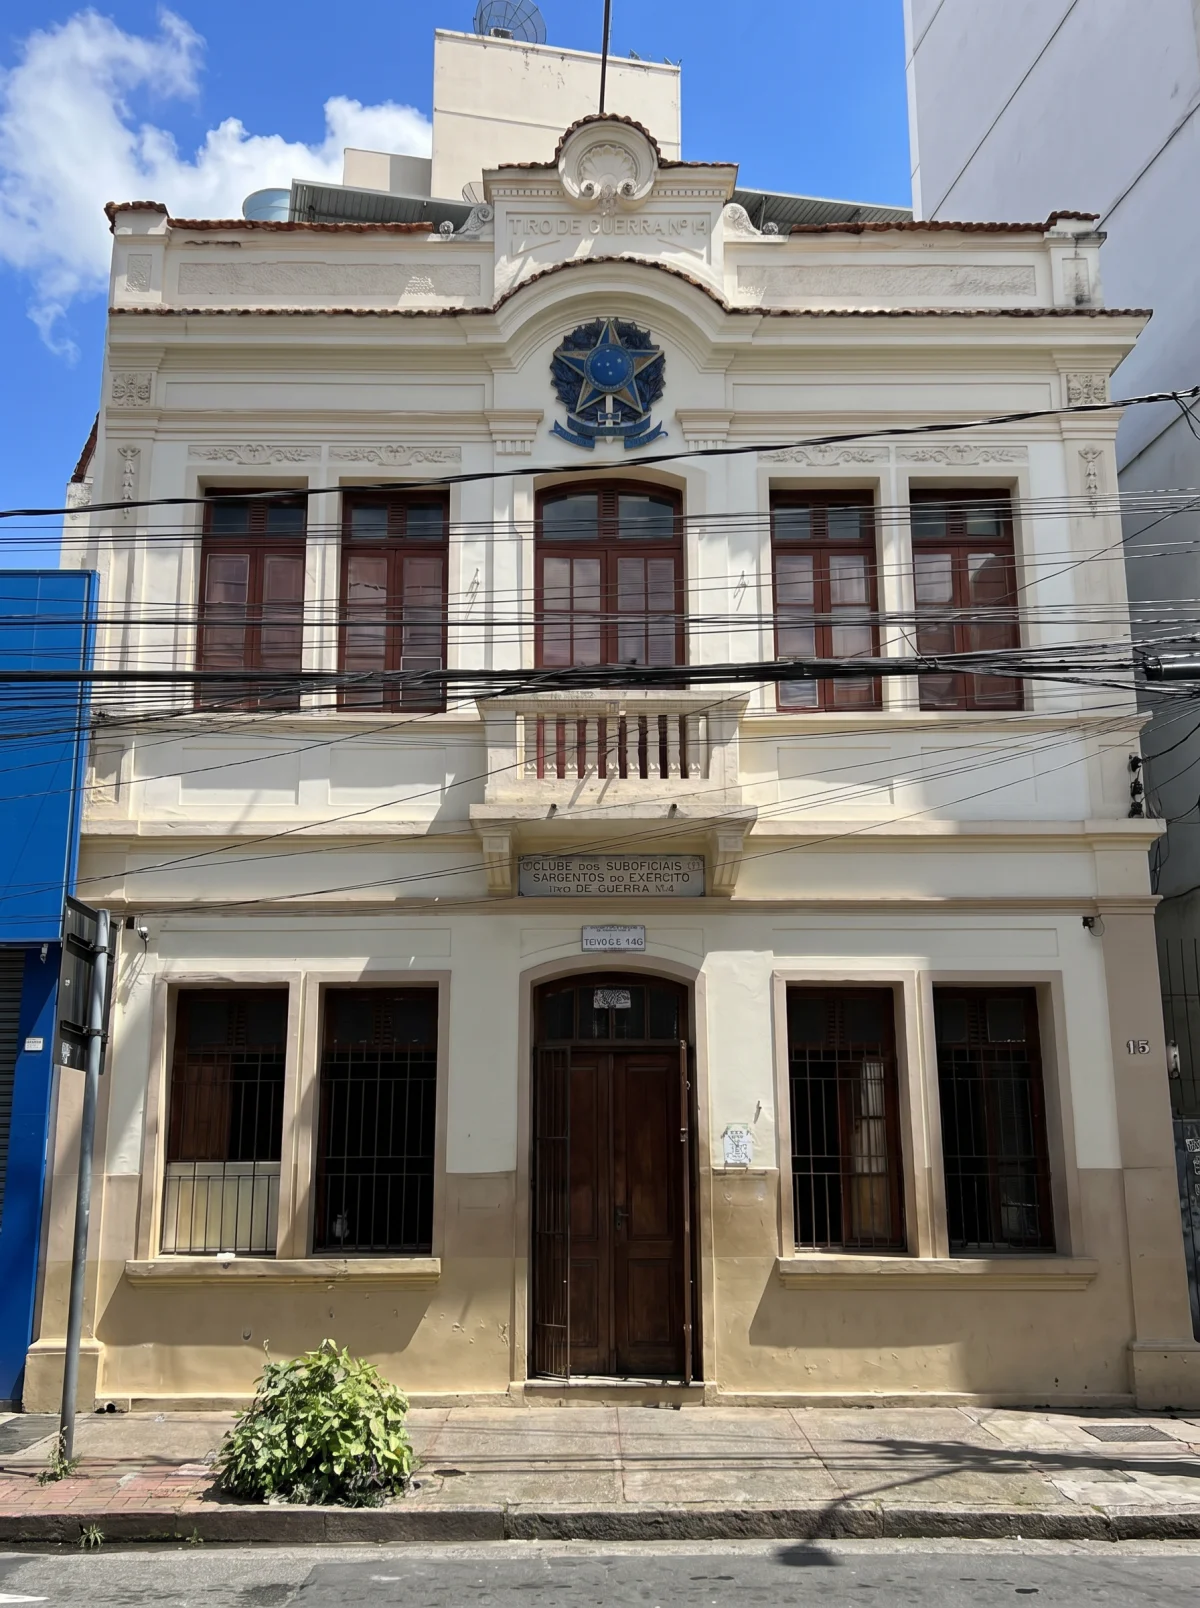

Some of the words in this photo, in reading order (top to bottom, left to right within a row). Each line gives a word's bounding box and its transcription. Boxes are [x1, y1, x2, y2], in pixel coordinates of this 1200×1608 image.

[508, 219, 553, 235] TIRO
[556, 219, 582, 235] DE
[588, 219, 666, 236] GUERRA
[533, 861, 573, 871] CLUBE
[606, 861, 682, 871] SUBOFICIAIS
[533, 872, 605, 882] SARGENTOS
[576, 884, 592, 893] DE
[597, 884, 650, 893] GUERRA
[1126, 1039, 1150, 1055] 15
